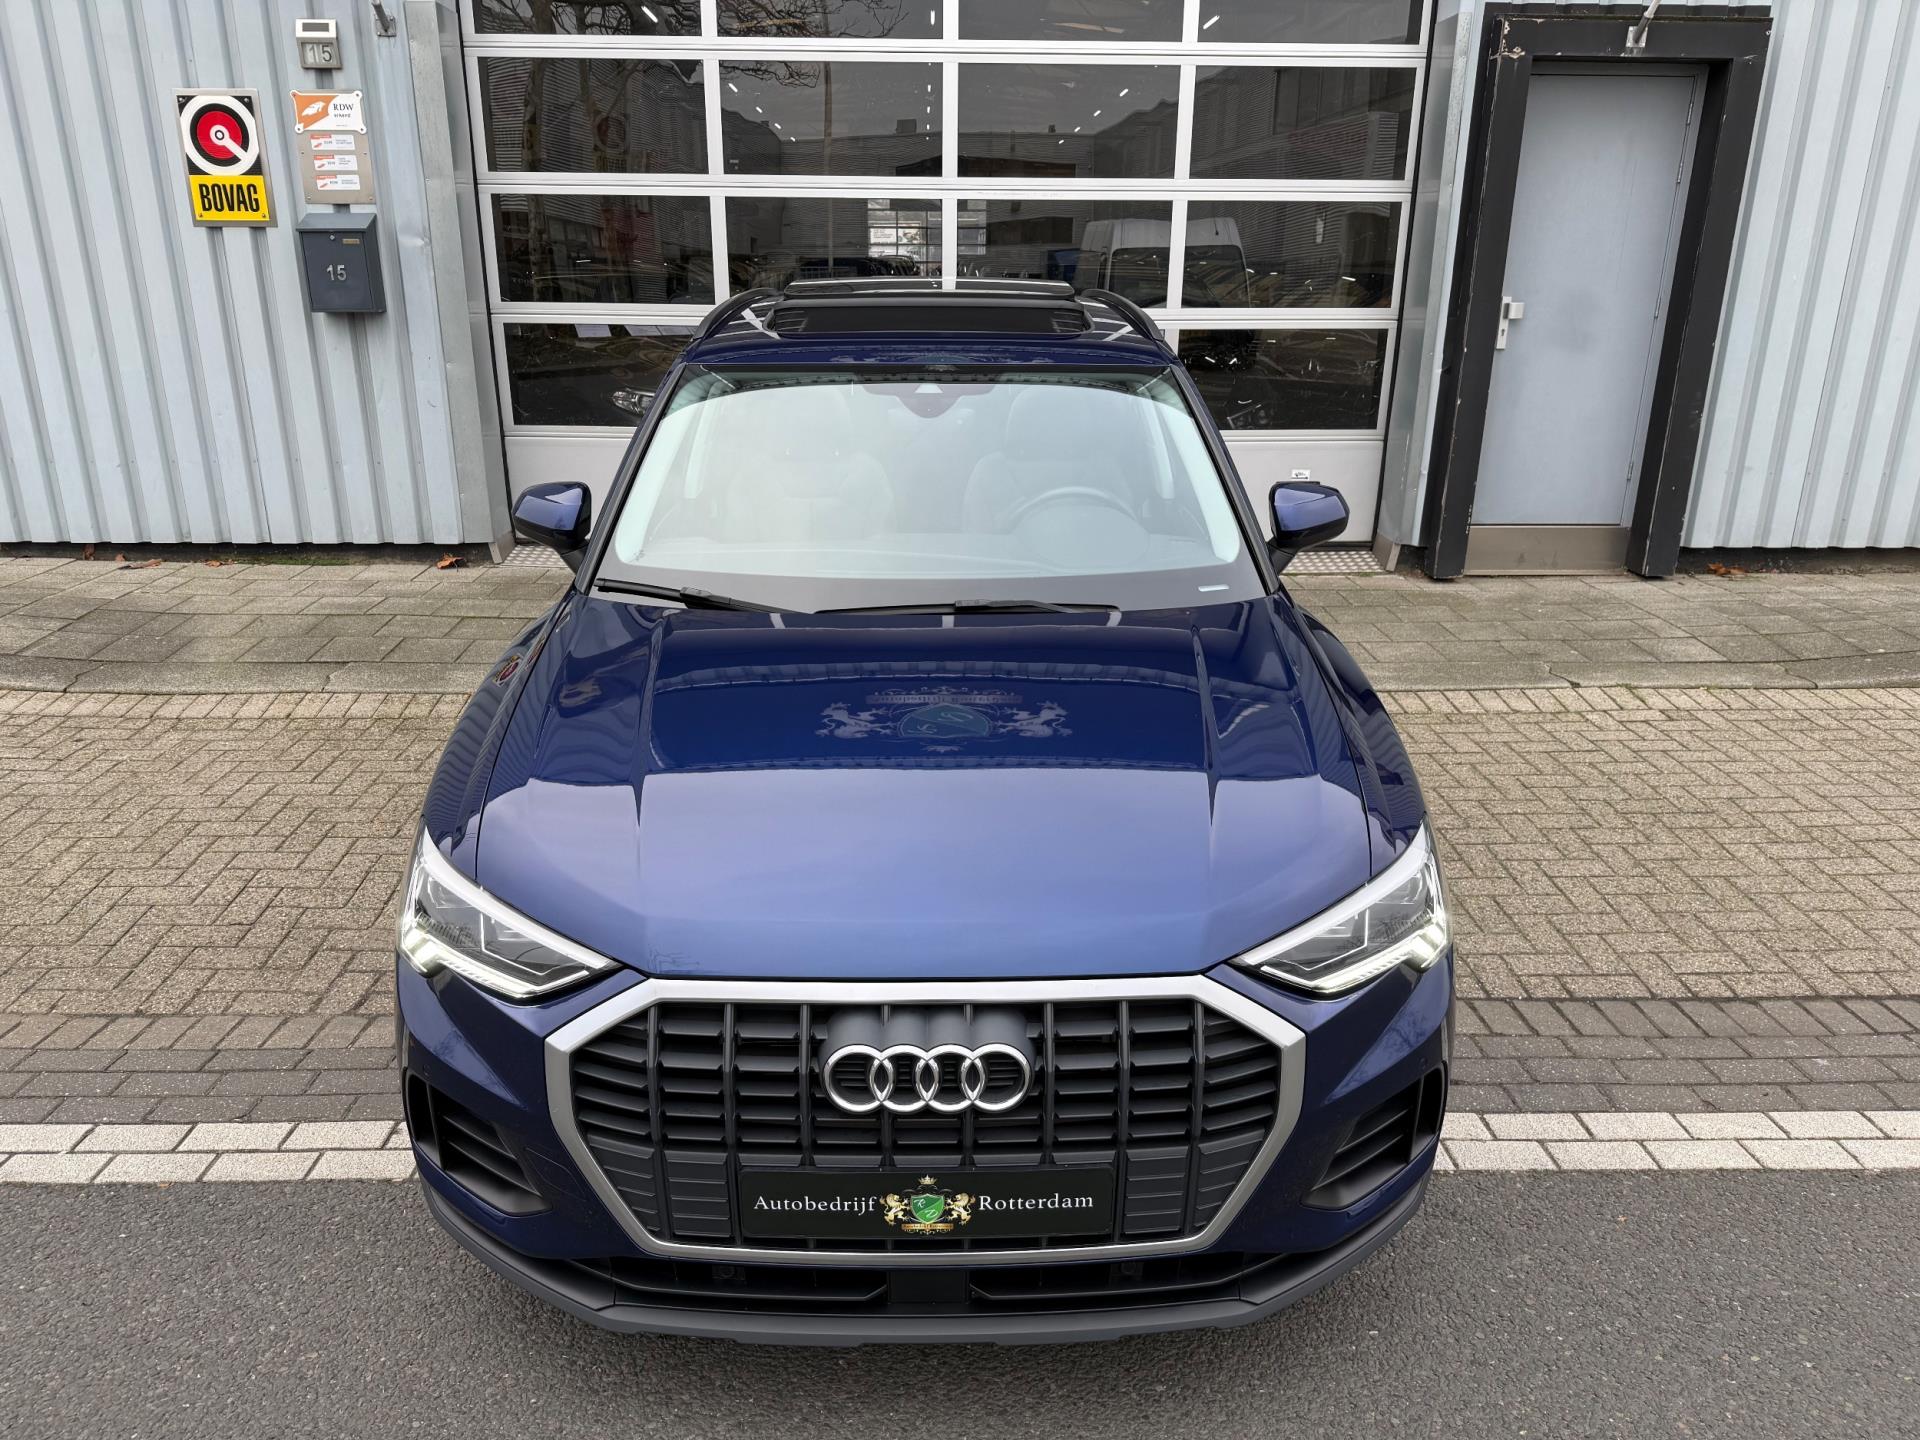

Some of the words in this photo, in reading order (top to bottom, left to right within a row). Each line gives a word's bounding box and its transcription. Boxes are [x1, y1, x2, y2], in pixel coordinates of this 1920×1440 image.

[308, 44, 332, 62] 15
[333, 103, 354, 111] RDW
[198, 183, 260, 212] BOVAG
[326, 264, 347, 281] 15
[753, 1195, 877, 1216] Autobedrijf
[978, 1192, 1094, 1211] Rotterdam
